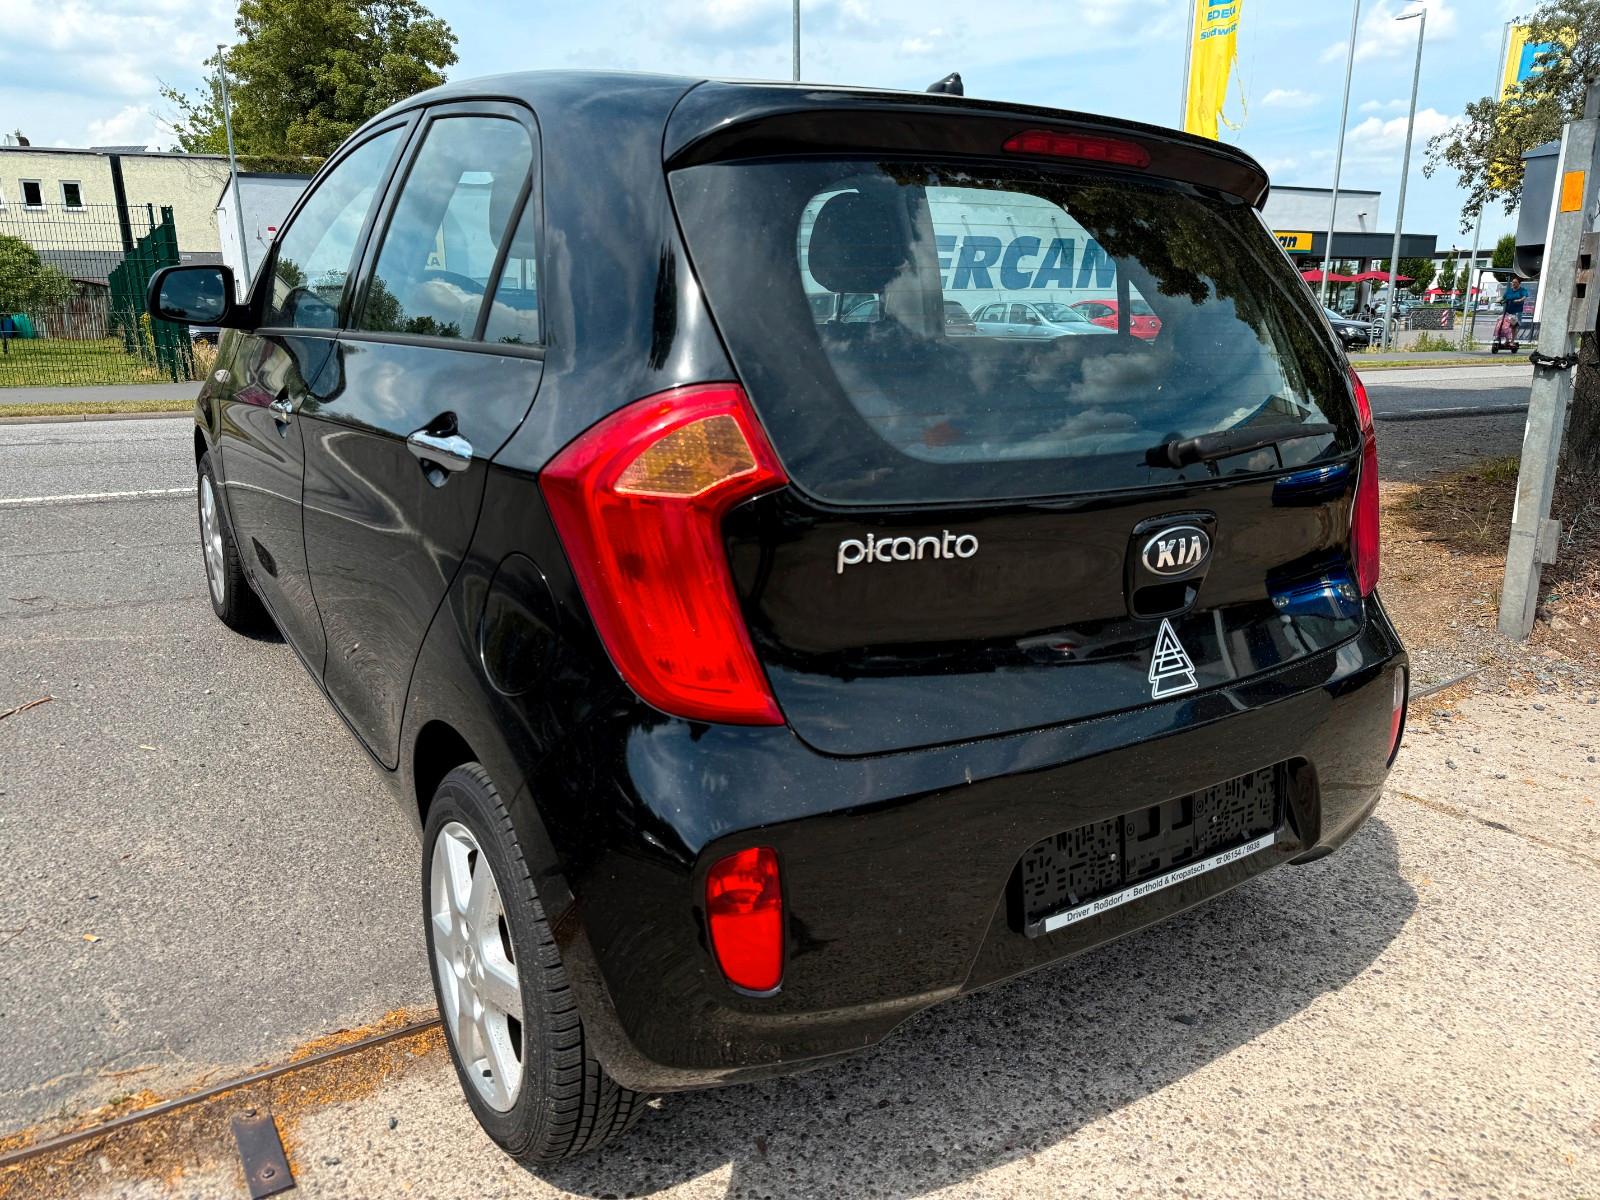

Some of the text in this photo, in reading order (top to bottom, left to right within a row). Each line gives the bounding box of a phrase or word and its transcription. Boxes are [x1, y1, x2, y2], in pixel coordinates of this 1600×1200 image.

[1207, 6, 1236, 22] EDE
[1200, 23, 1237, 40] Südwst
[836, 529, 979, 575] picanto
[1156, 535, 1202, 568] KIA
[1066, 907, 1090, 922] Driver
[1093, 893, 1124, 912] Roßdorf
[1133, 878, 1163, 897] Berthold
[1171, 863, 1205, 883] Kropatsch
